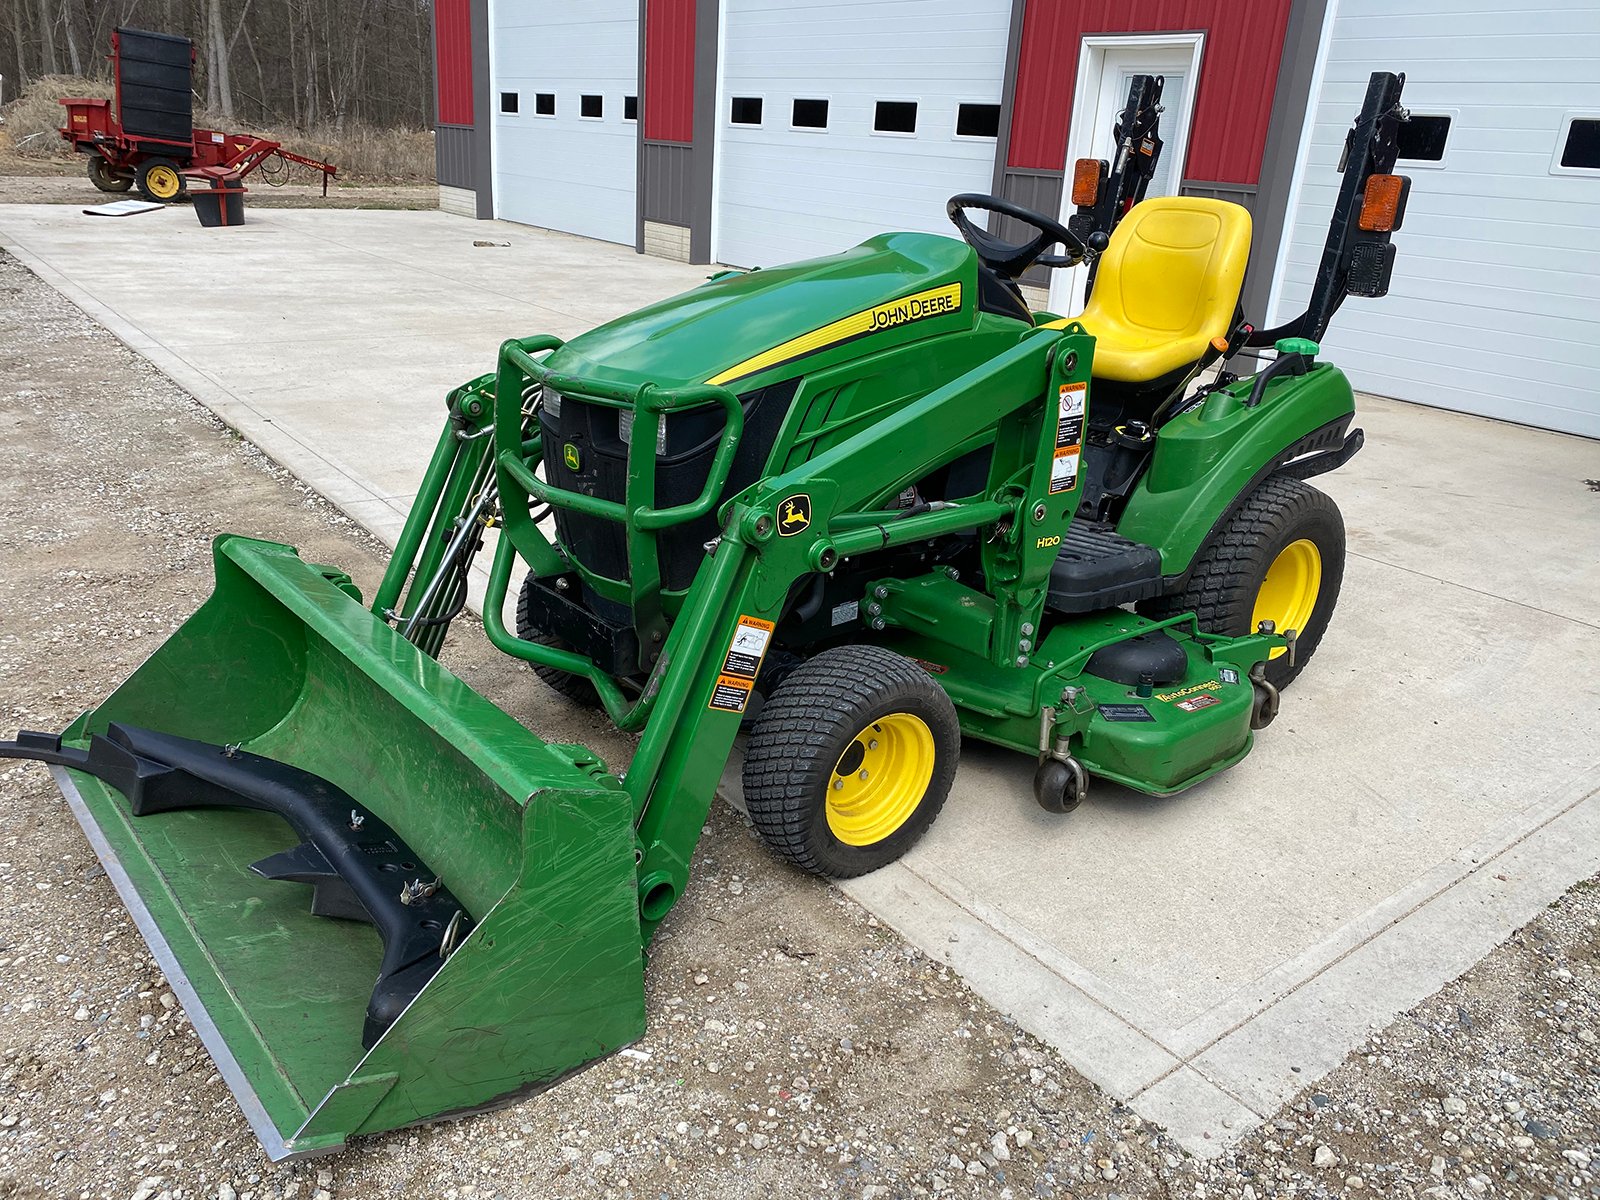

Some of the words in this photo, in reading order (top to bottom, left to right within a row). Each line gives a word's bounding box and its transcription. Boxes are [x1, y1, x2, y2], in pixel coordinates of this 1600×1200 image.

[869, 305, 909, 329] JOHN
[910, 295, 954, 317] DEERE
[1064, 383, 1086, 393] WARNING
[1058, 447, 1080, 457] WARNING
[1036, 535, 1061, 549] H120
[748, 619, 770, 630] WARNING
[727, 679, 749, 688] WARNING
